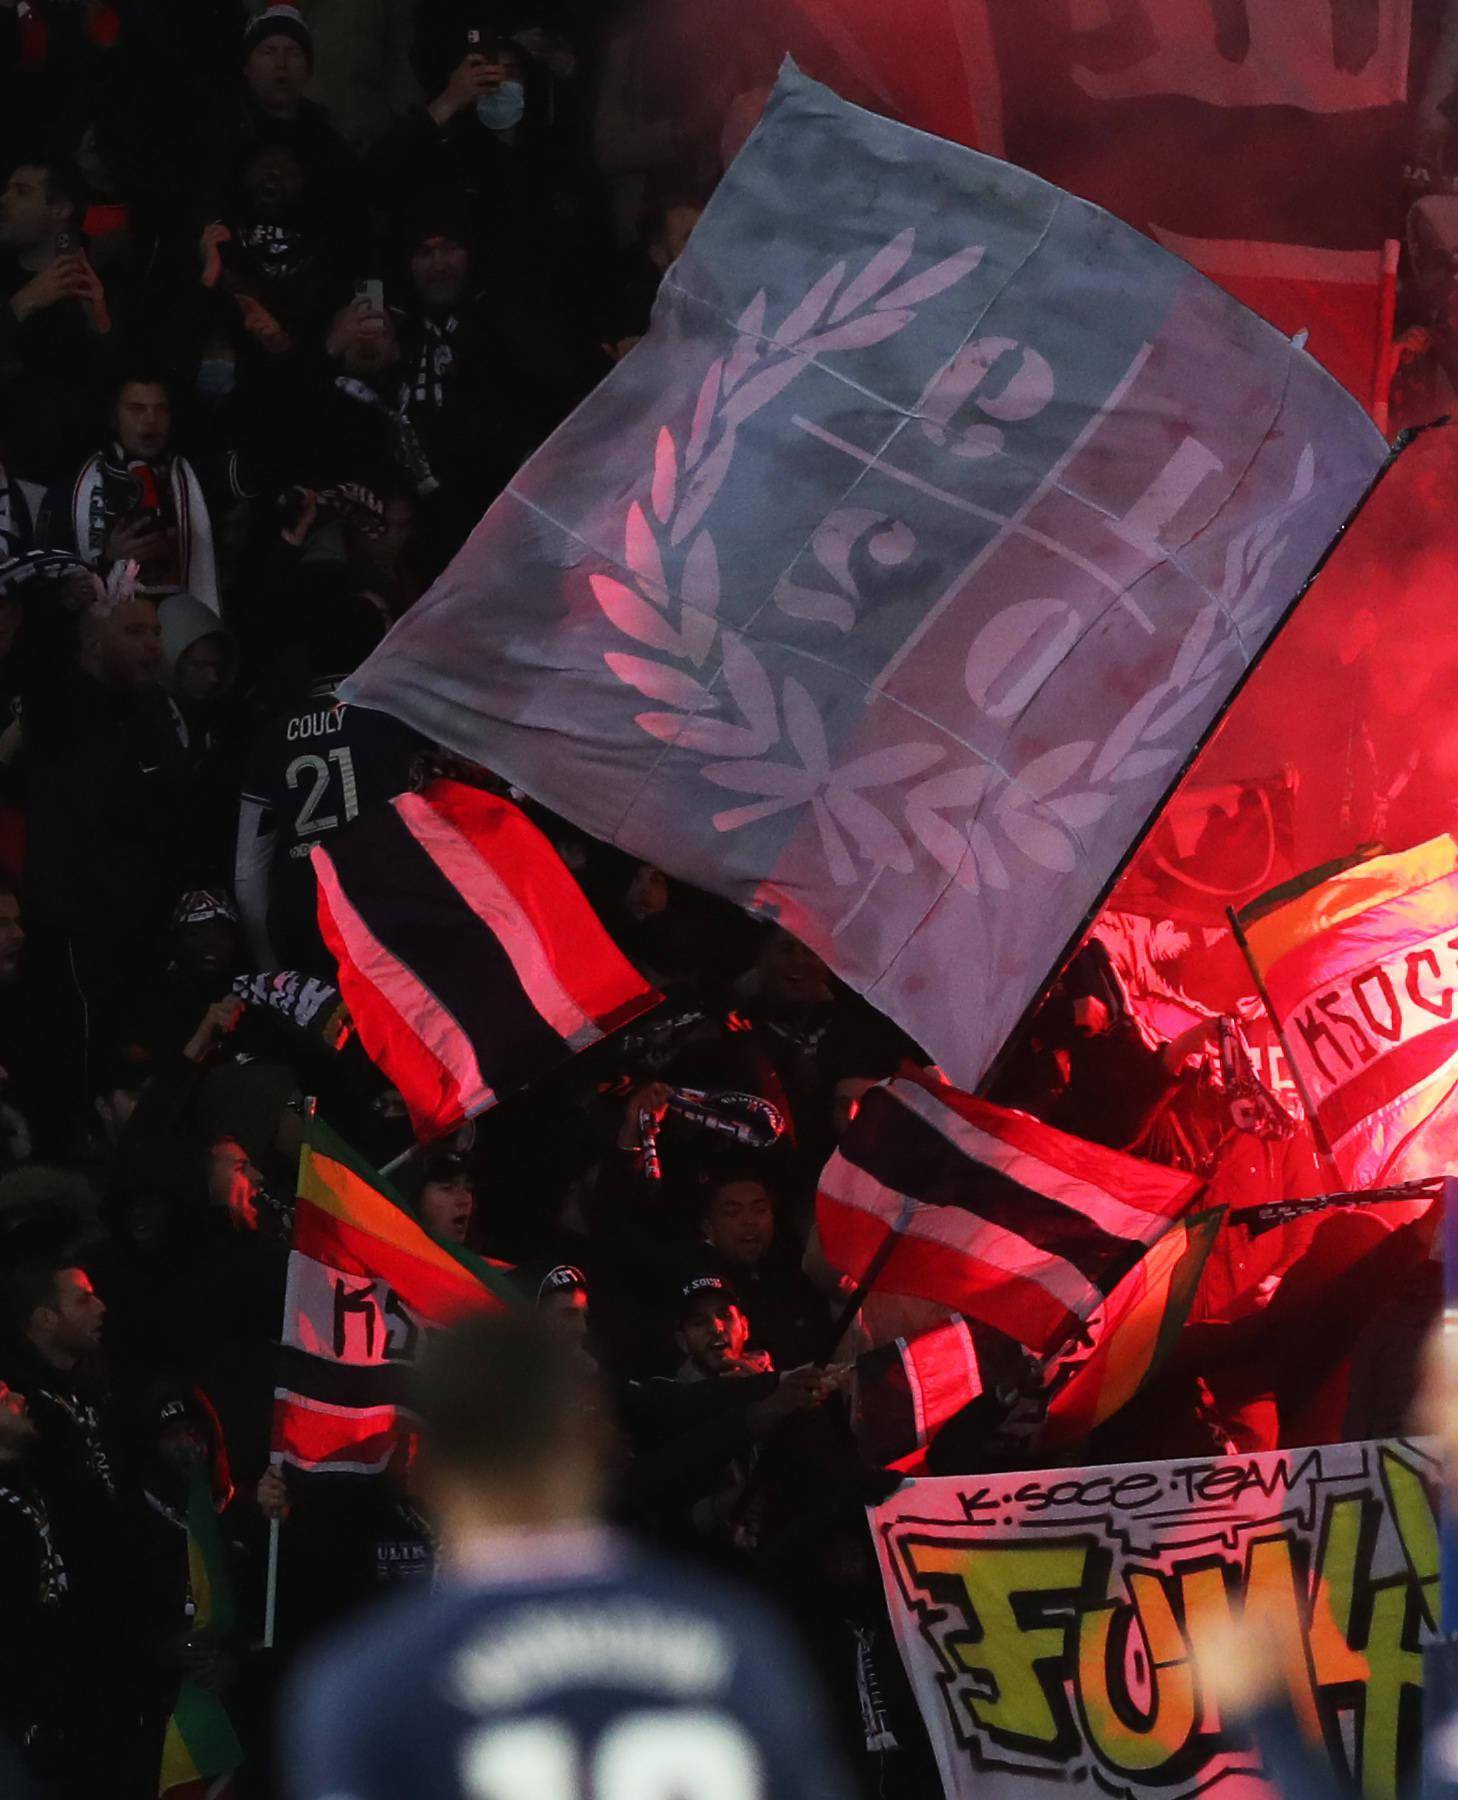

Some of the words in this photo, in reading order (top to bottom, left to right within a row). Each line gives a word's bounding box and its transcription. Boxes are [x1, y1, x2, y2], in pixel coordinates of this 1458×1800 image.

[286, 706, 347, 741] COULY
[285, 746, 359, 837] 21
[333, 1278, 418, 1362] KS
